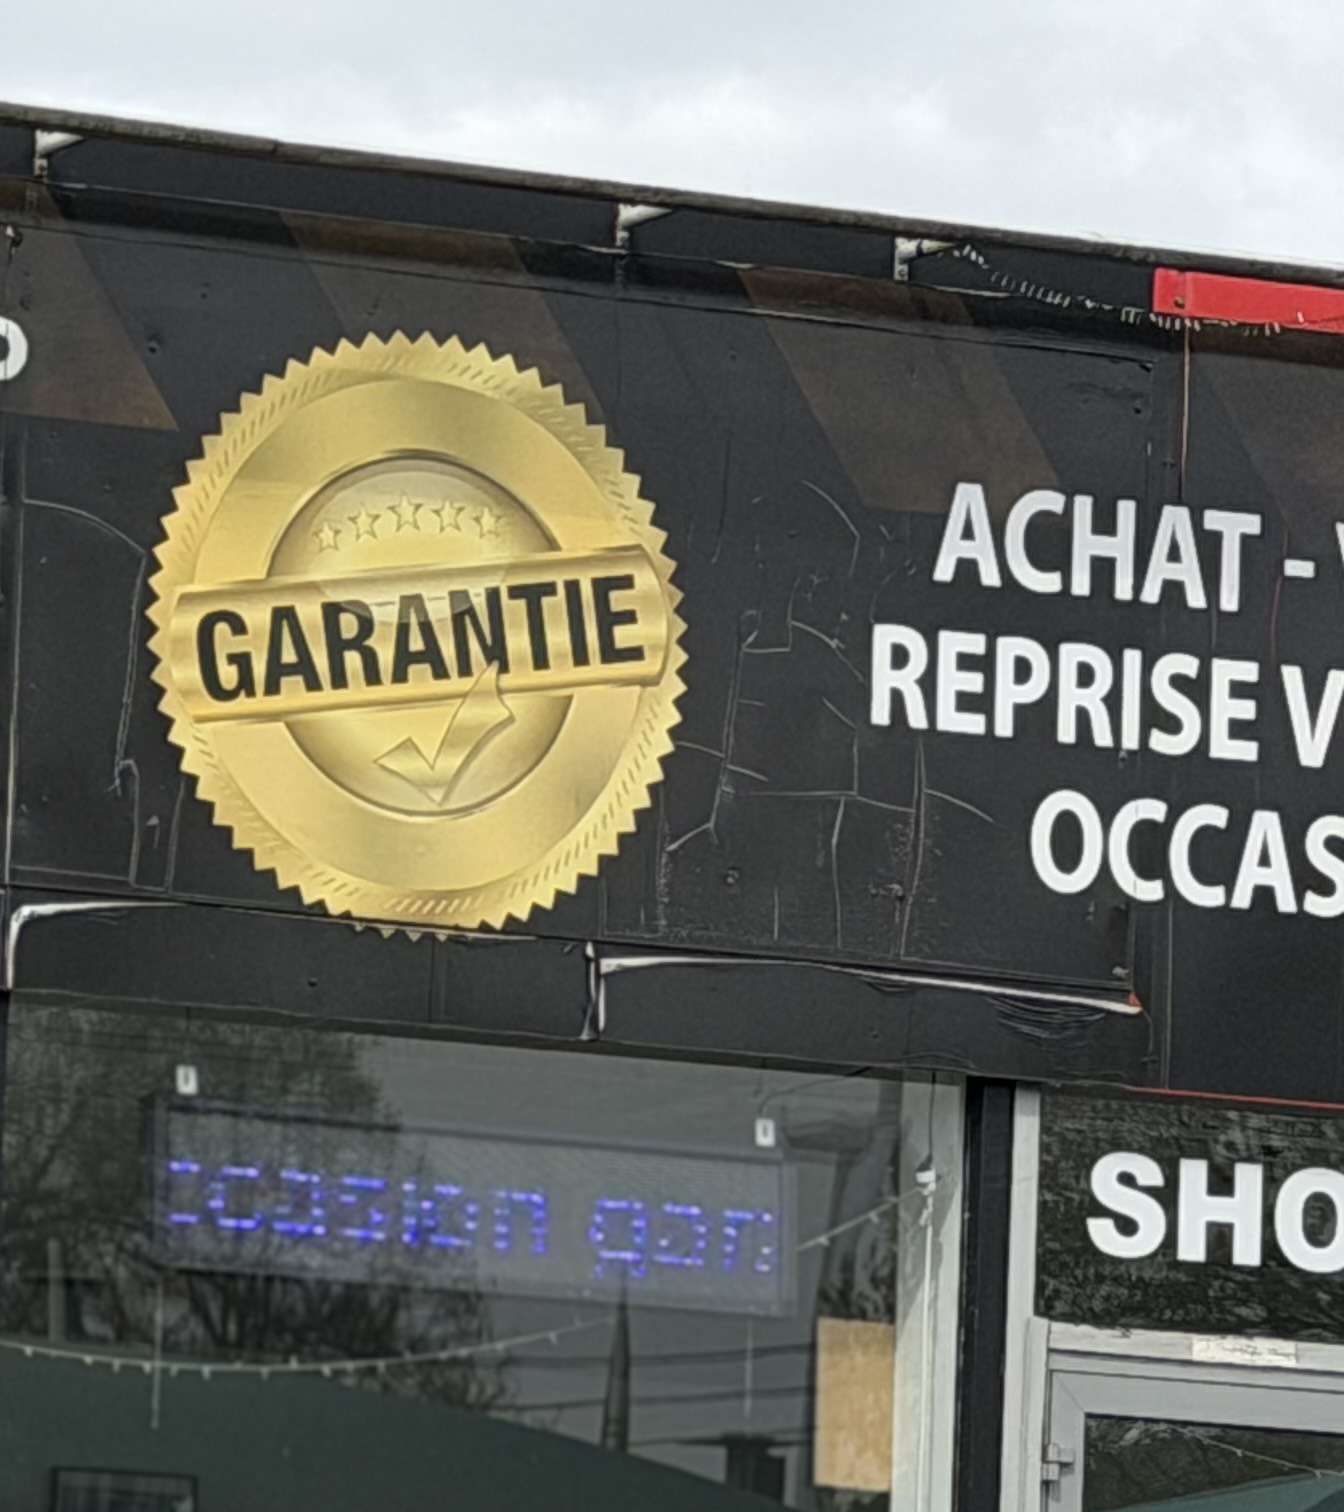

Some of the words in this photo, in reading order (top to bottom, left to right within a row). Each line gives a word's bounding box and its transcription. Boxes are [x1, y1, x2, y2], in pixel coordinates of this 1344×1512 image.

[932, 481, 1261, 612] ACHAT
[196, 573, 645, 702] GARANTIE
[870, 623, 1259, 761] REPRISE
[1030, 789, 1344, 918] OCCAS
[1085, 1151, 1344, 1274] SHO
